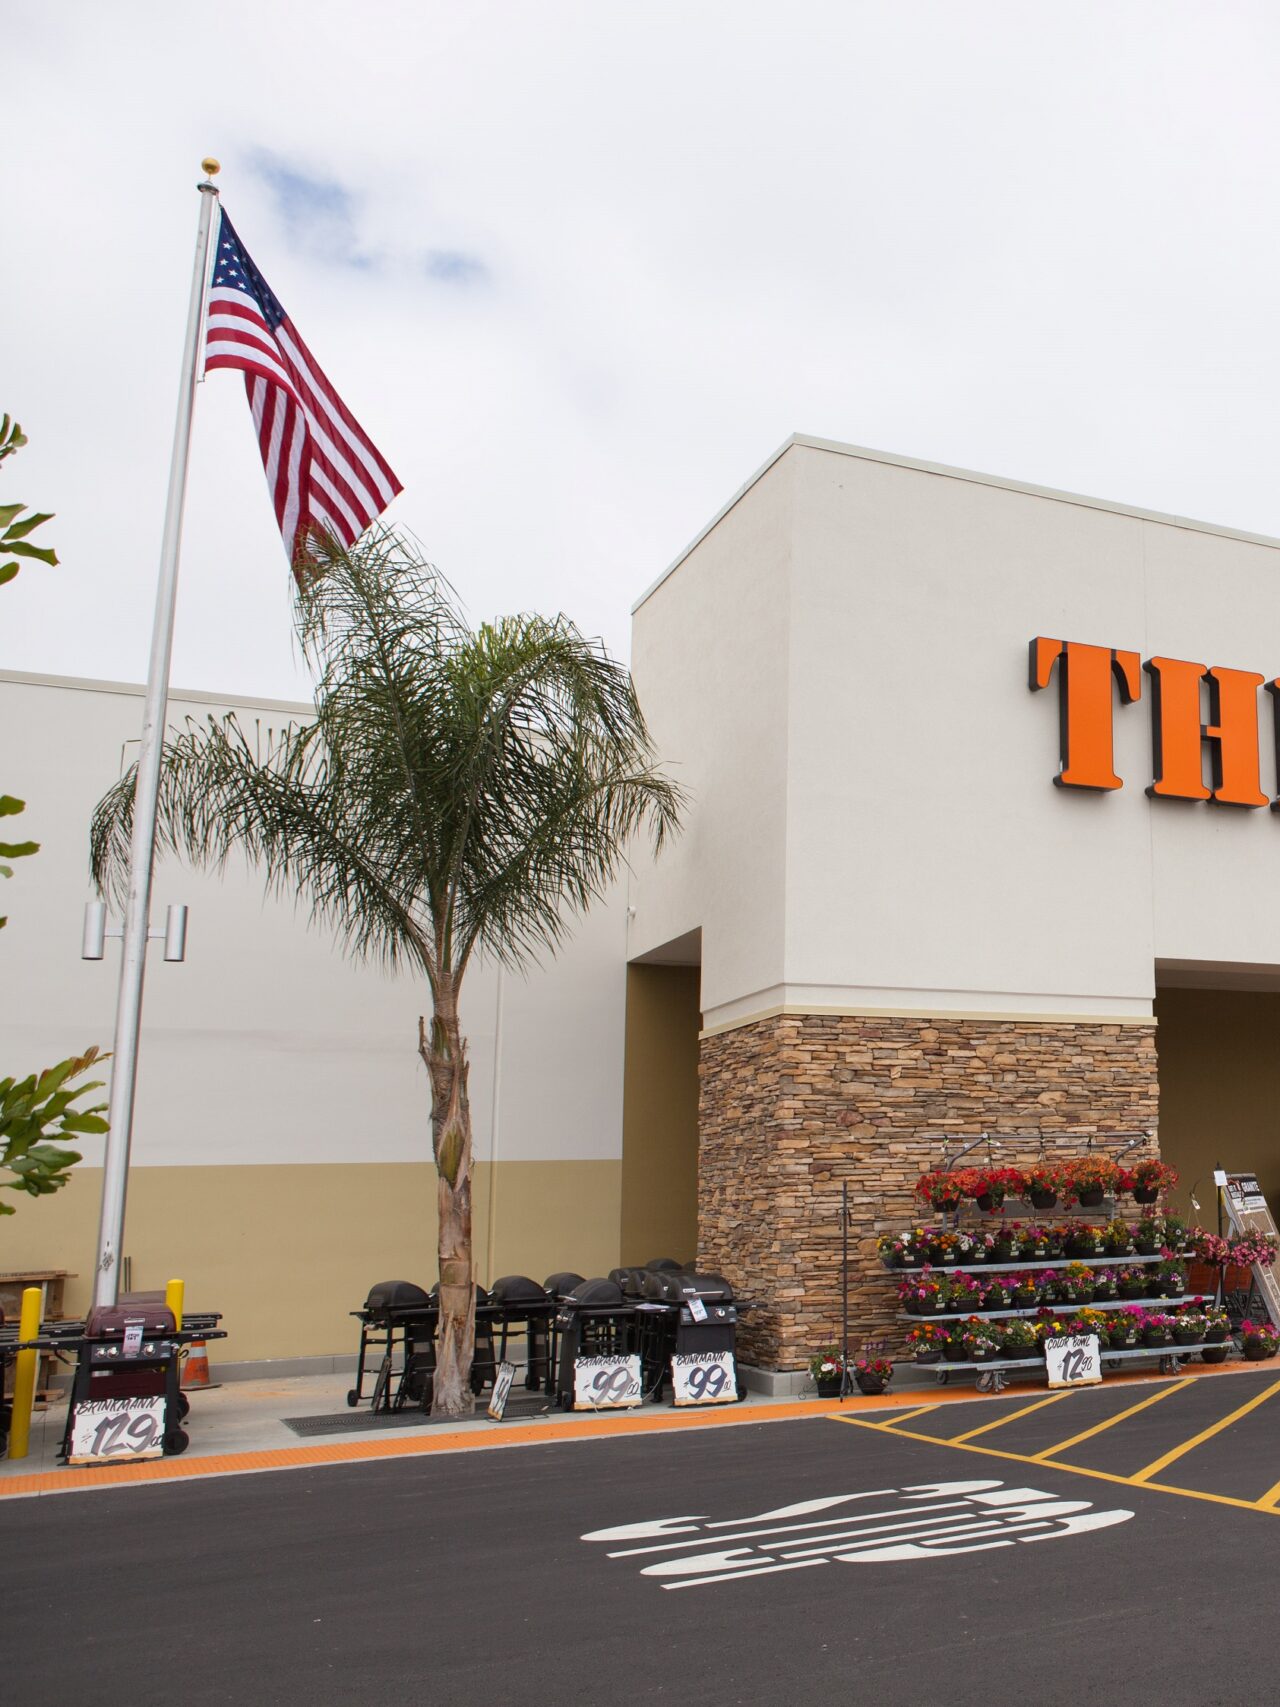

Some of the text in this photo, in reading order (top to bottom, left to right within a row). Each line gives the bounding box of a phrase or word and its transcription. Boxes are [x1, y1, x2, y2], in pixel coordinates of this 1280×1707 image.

[676, 1351, 727, 1366] BRINKMANN
[1047, 1335, 1091, 1350] COLOR BOWL
[577, 1354, 630, 1368] BRINKMANN
[1062, 1348, 1085, 1381] 12
[588, 1366, 634, 1405] 99
[688, 1364, 727, 1399] 99
[77, 1395, 160, 1415] BRINKMANN
[91, 1412, 158, 1456] 129
[581, 1480, 1135, 1589] STOP
